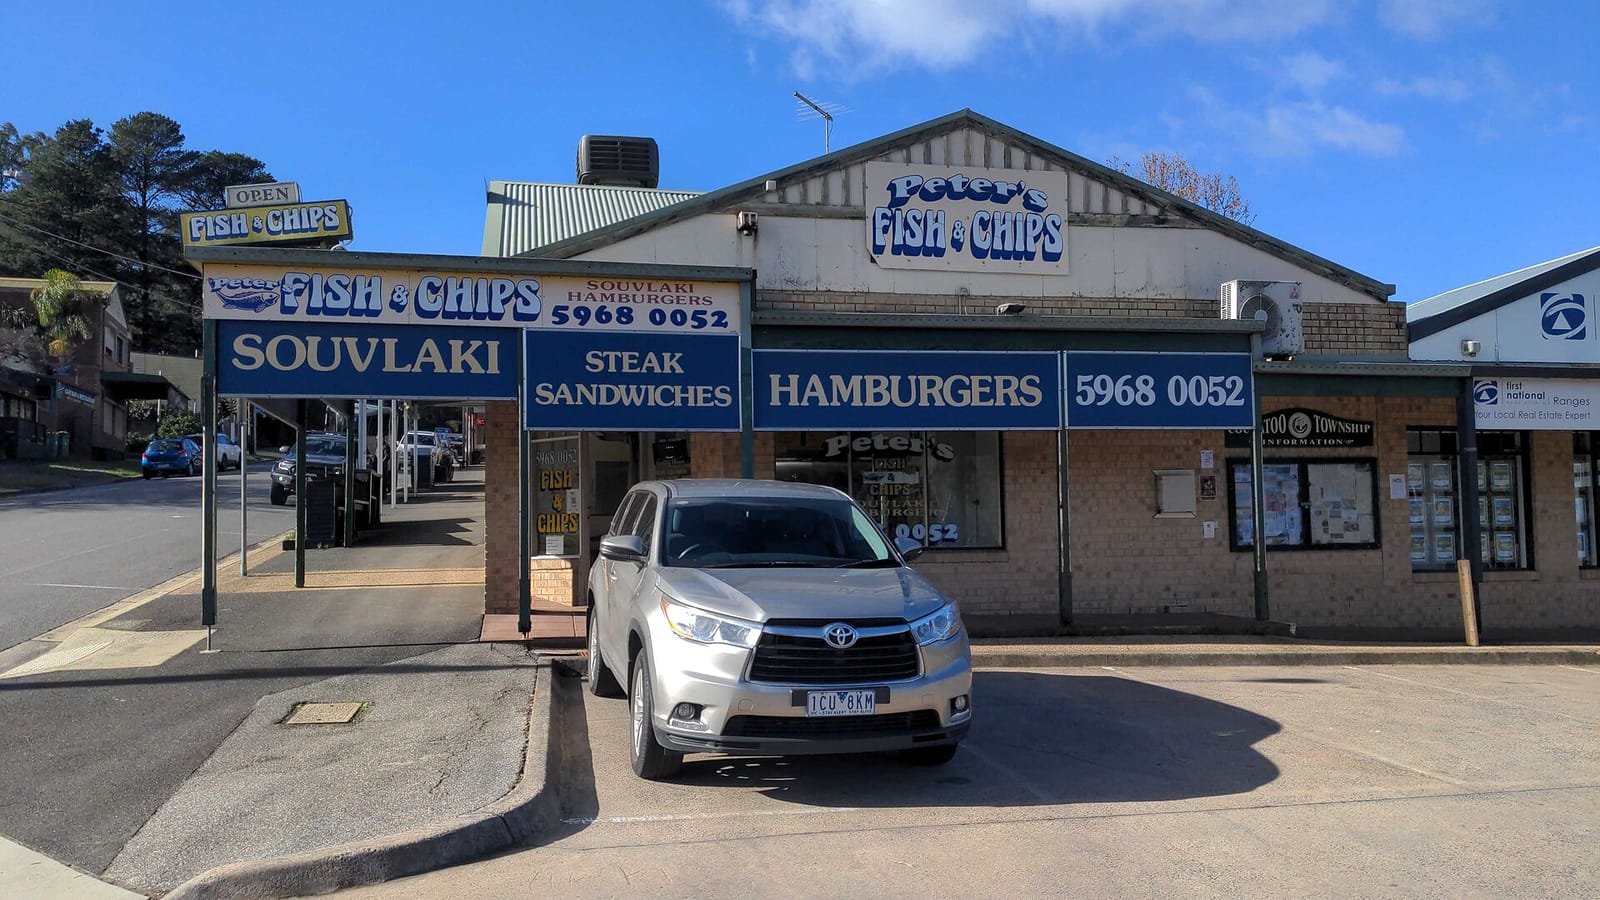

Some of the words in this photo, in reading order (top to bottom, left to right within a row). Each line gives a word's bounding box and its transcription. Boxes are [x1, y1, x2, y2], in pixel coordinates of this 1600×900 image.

[236, 187, 288, 203] OPEN
[887, 173, 1048, 213] Peter's
[190, 213, 249, 241] FISH
[252, 216, 263, 233] &
[266, 205, 340, 235] CHIPS
[872, 206, 946, 257] FISH
[951, 220, 965, 252] &
[970, 210, 1063, 262] CHIPS
[211, 277, 293, 294] Peter's
[586, 280, 694, 293] SOUVLAKI
[280, 272, 382, 317] FISH
[389, 285, 409, 313] &
[414, 276, 542, 321] CHIPS
[567, 291, 713, 306] HAMBURGERS
[551, 304, 634, 326] 5968
[649, 308, 728, 329] 0052
[232, 333, 500, 374] SOUVLAKI
[585, 351, 684, 374] STEAK
[535, 383, 732, 407] SANDWICHES
[769, 373, 1042, 408] HAMBURGERS
[1075, 374, 1155, 406] 5968
[1168, 375, 1245, 407] 0052
[1506, 381, 1522, 390] first
[1506, 391, 1545, 400] national
[1553, 397, 1590, 408] Ranges
[1313, 414, 1371, 433] TOWNSHIP
[1475, 410, 1491, 419] Your
[1494, 410, 1516, 419] Local
[1519, 409, 1536, 419] Real
[1539, 409, 1562, 419] Estate
[1565, 409, 1591, 421] Expert
[824, 434, 954, 459] Peter's
[541, 470, 573, 490] FISH
[887, 473, 895, 482] &
[870, 484, 912, 495] CHIPS
[552, 493, 563, 512] &
[537, 513, 579, 533] CHIPS
[895, 523, 958, 542] 0052
[847, 694, 873, 709] 8KM
